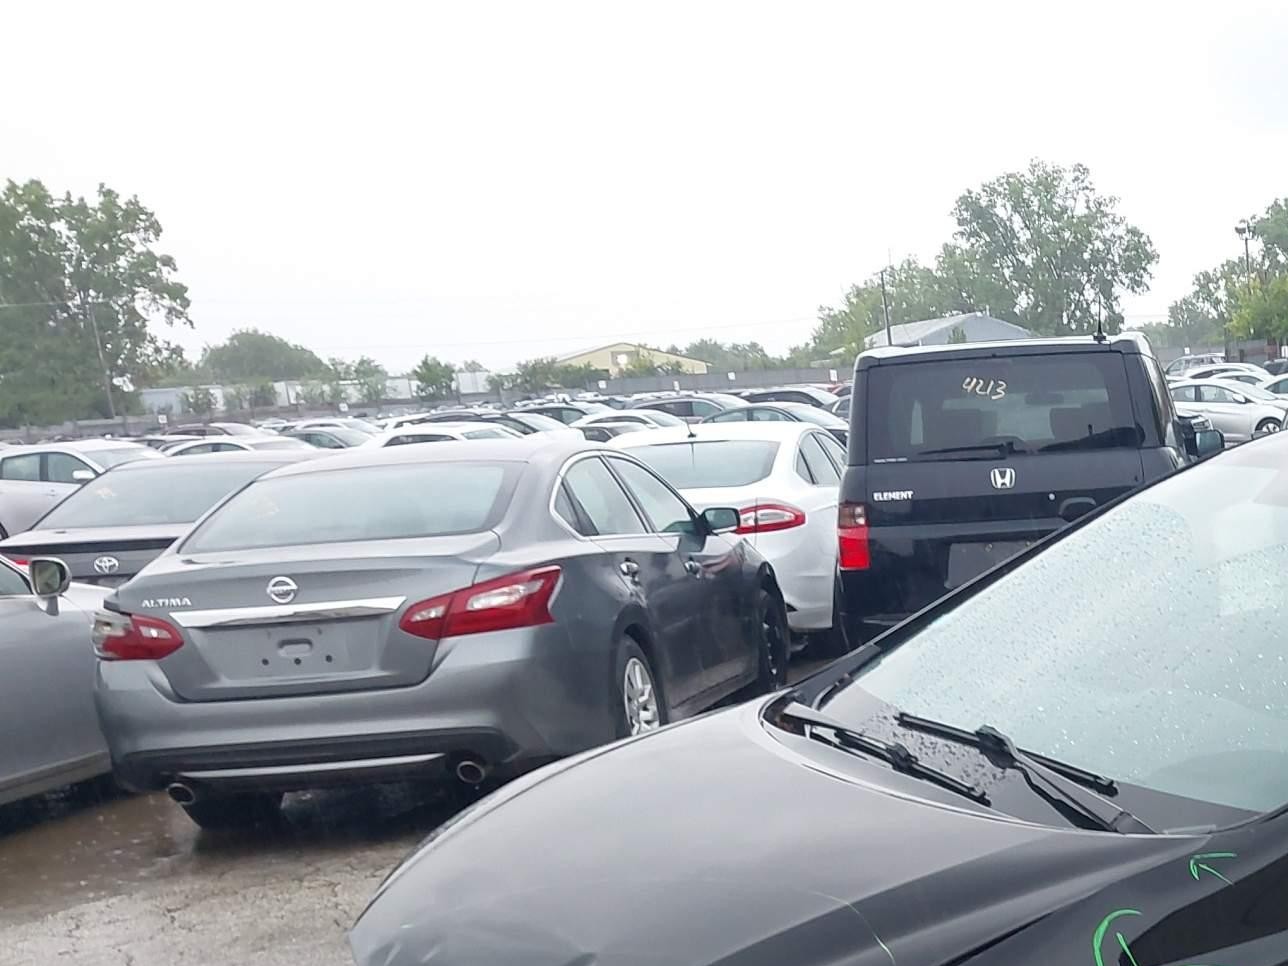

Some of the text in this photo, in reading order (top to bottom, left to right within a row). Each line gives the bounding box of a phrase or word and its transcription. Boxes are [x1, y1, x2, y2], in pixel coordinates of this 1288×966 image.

[962, 377, 1006, 399] 4213
[873, 490, 914, 501] ELEMENT
[141, 597, 192, 608] ALTIMA
